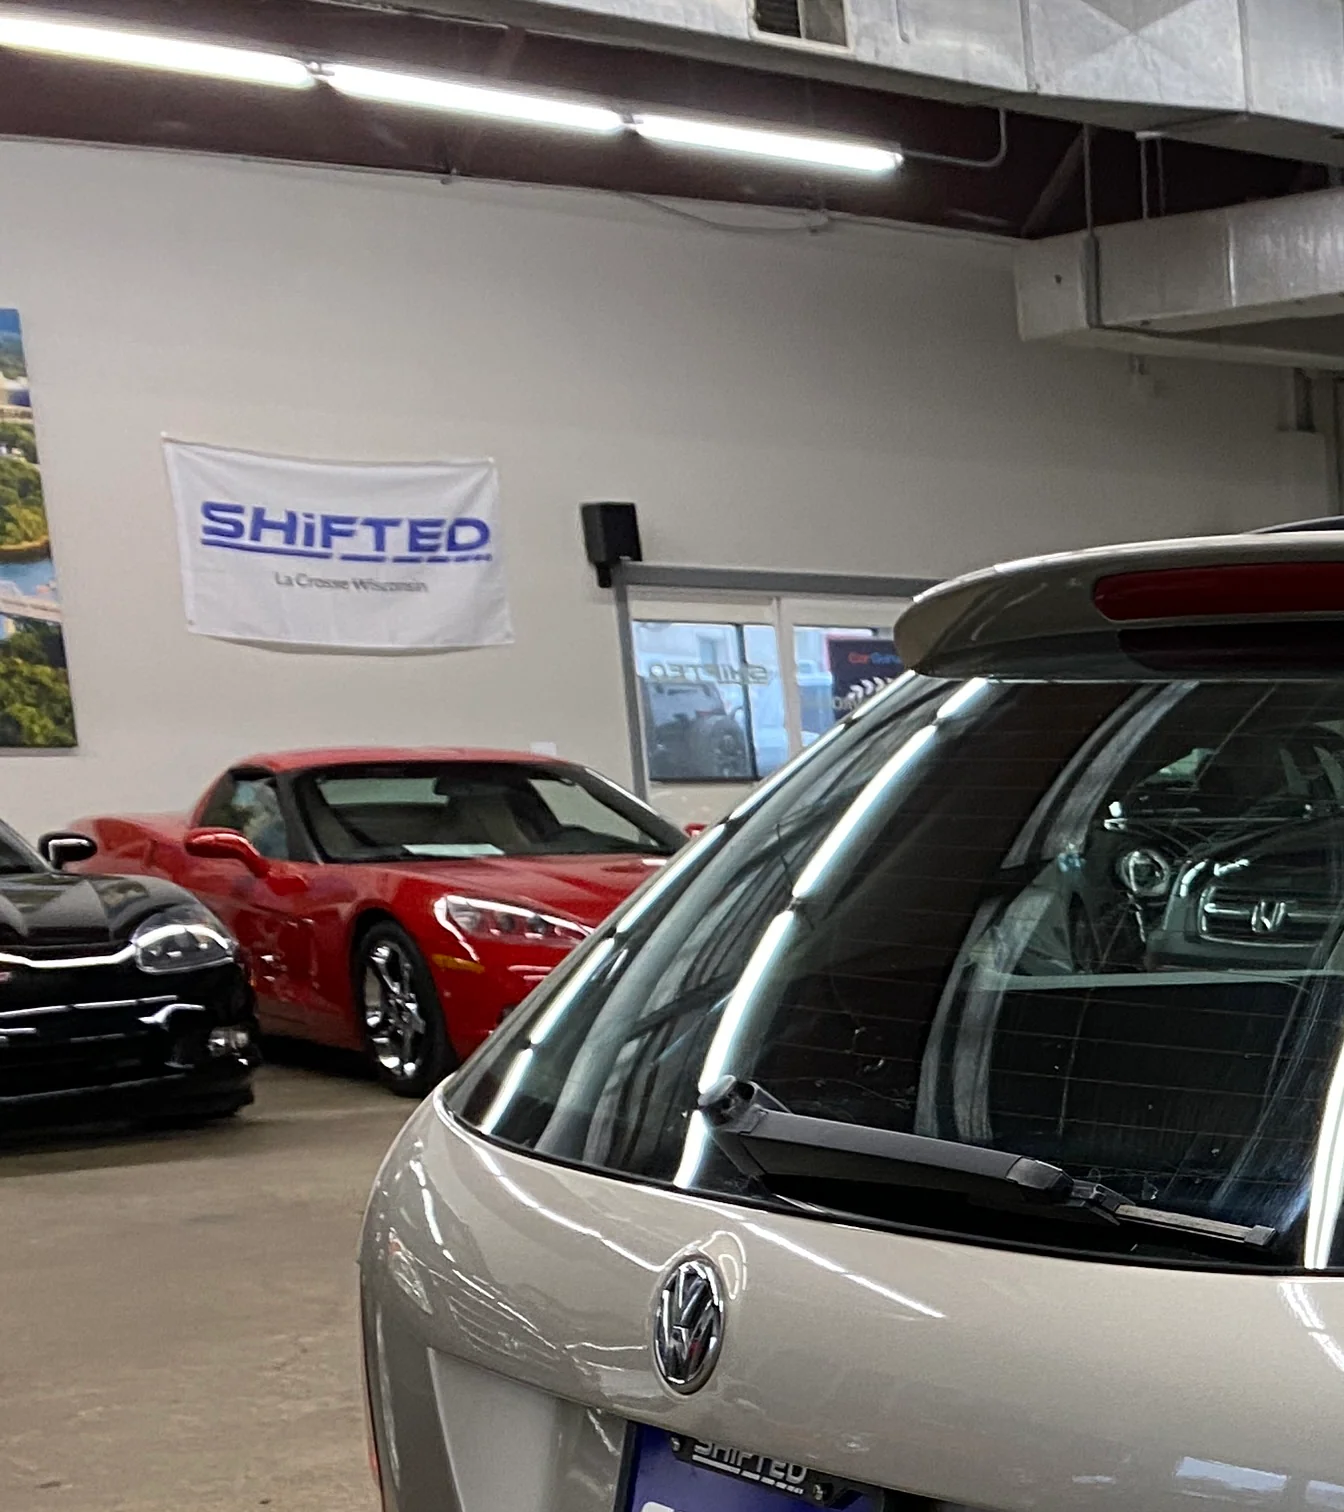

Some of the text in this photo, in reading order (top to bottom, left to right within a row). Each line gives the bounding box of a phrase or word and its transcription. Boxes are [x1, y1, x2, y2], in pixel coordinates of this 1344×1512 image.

[275, 571, 429, 592] La Crosse Wisconsin
